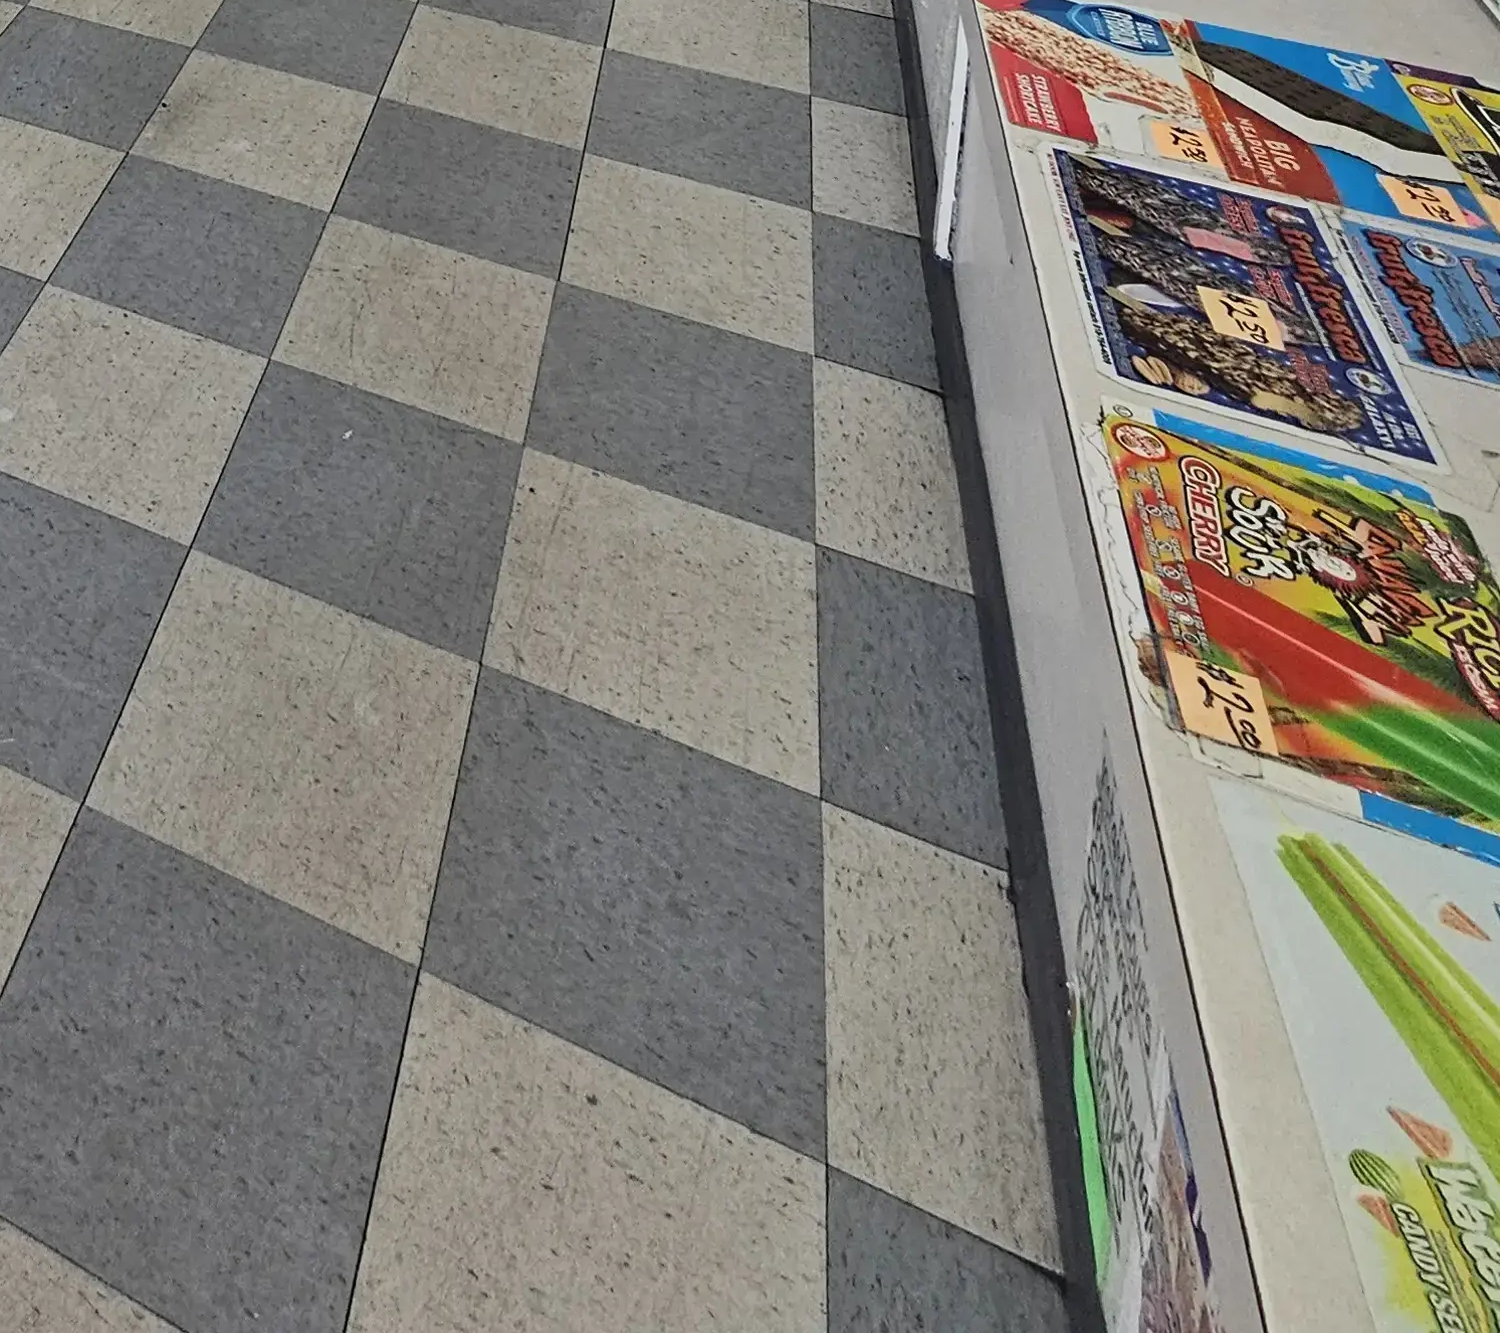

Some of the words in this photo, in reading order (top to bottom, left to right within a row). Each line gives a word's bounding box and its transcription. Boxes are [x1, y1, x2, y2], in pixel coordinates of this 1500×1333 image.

[1099, 8, 1144, 49] RIBBON
[1136, 22, 1158, 46] BLUE
[1016, 73, 1041, 124] SHORTCAKE
[1032, 74, 1062, 132] STRAWBERRY
[1222, 121, 1254, 169] SANDWICH
[1236, 117, 1285, 189] NEAPOLITAN
[1264, 139, 1301, 171] BIG
[1180, 457, 1231, 578] CHERRY
[1392, 1203, 1452, 1294] CANDY
